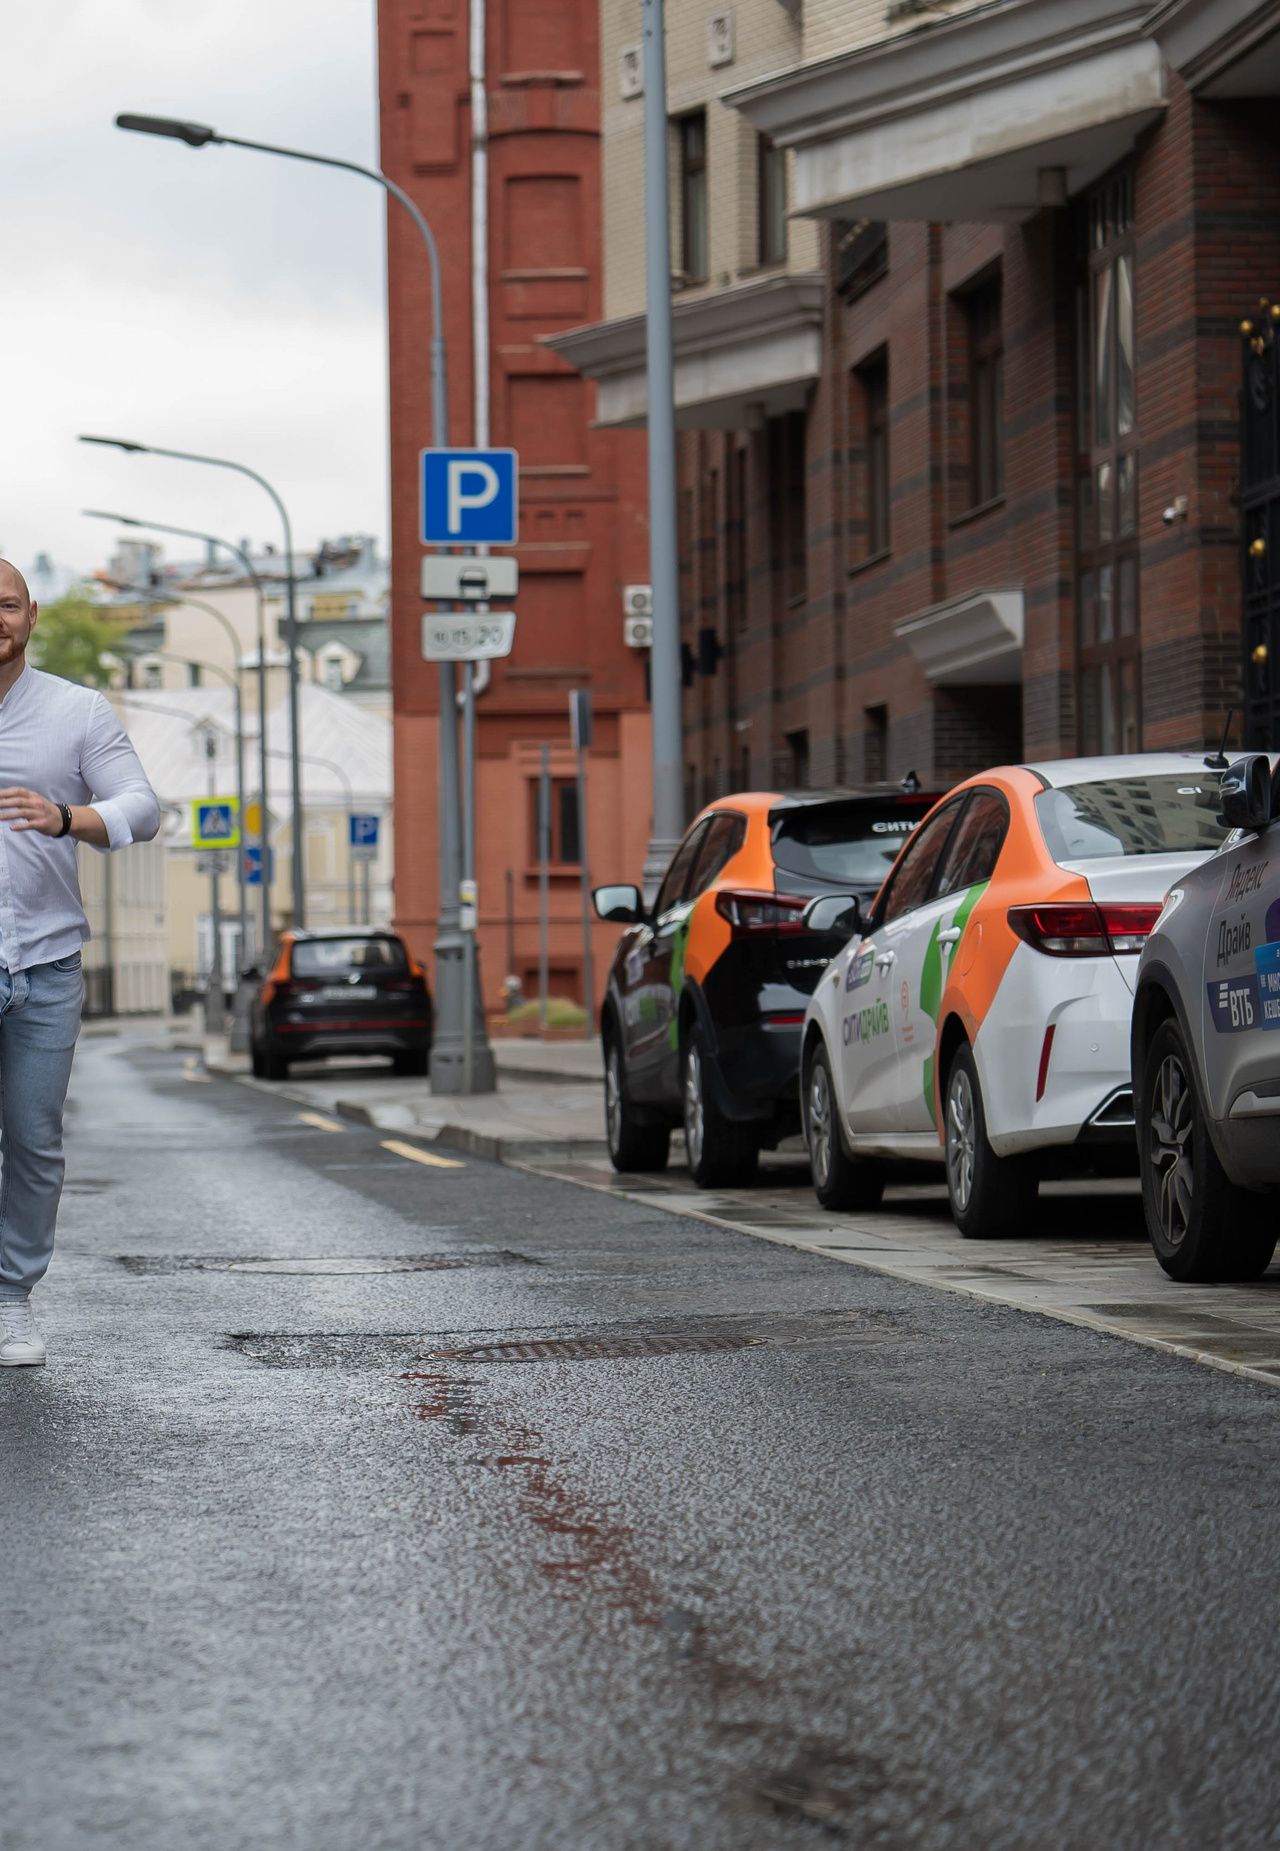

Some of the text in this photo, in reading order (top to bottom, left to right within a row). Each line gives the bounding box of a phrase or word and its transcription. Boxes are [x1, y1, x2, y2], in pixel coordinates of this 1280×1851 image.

[448, 461, 500, 534] P
[1225, 861, 1269, 902] Яндекс
[1217, 913, 1251, 968] Драйв
[1229, 988, 1254, 1026] ВТБ
